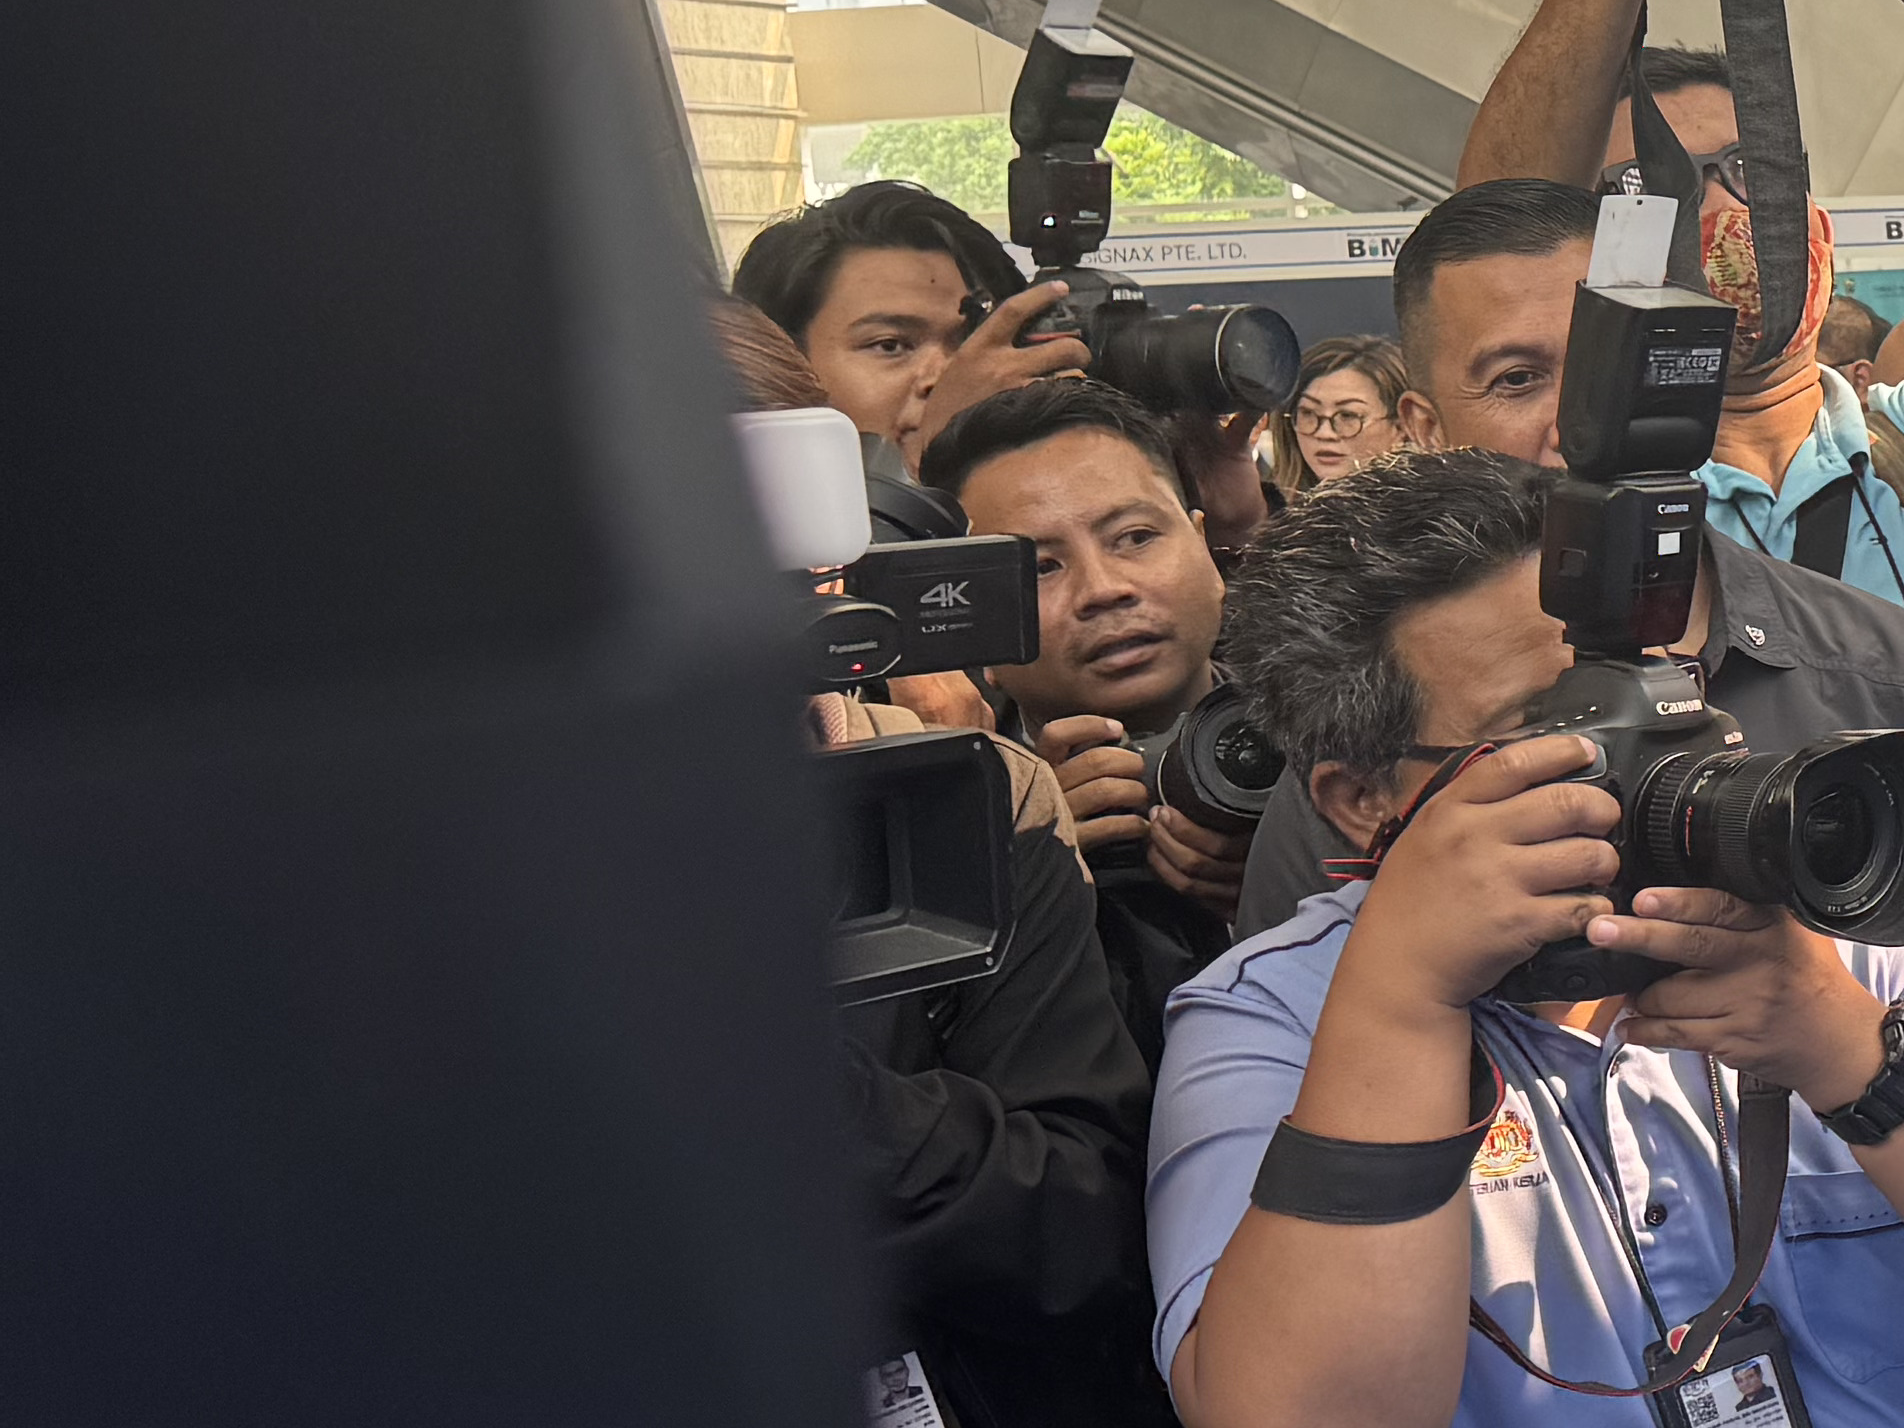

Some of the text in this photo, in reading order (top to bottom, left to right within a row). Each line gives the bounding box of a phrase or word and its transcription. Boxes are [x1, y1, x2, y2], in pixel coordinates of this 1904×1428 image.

[1162, 243, 1202, 262] PTE.
[1207, 242, 1248, 260] LTD.
[920, 580, 972, 607] 4K
[1656, 699, 1704, 716] Canon
